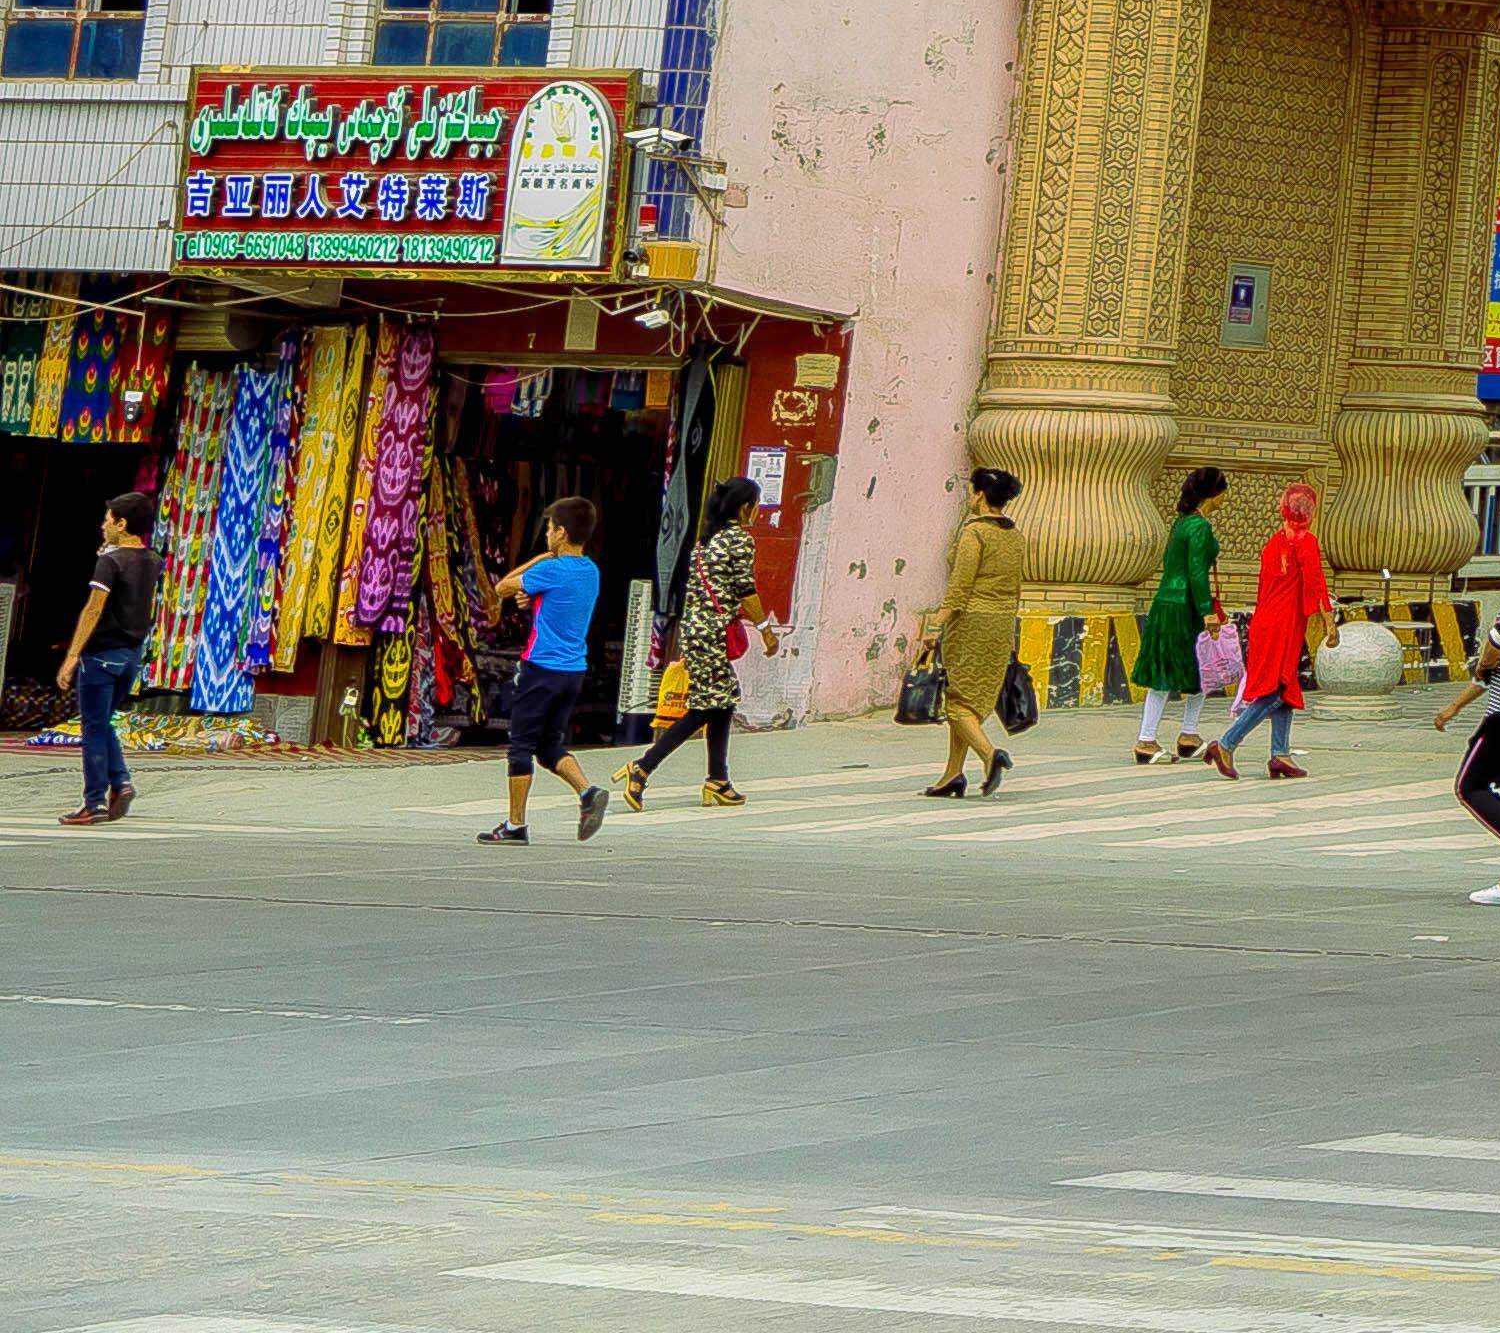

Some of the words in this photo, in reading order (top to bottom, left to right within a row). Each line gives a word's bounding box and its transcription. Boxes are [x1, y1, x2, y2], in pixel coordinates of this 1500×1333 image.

[186, 170, 490, 221] 吉亚丽人艾特莱斯
[308, 235, 399, 262] 13899460212
